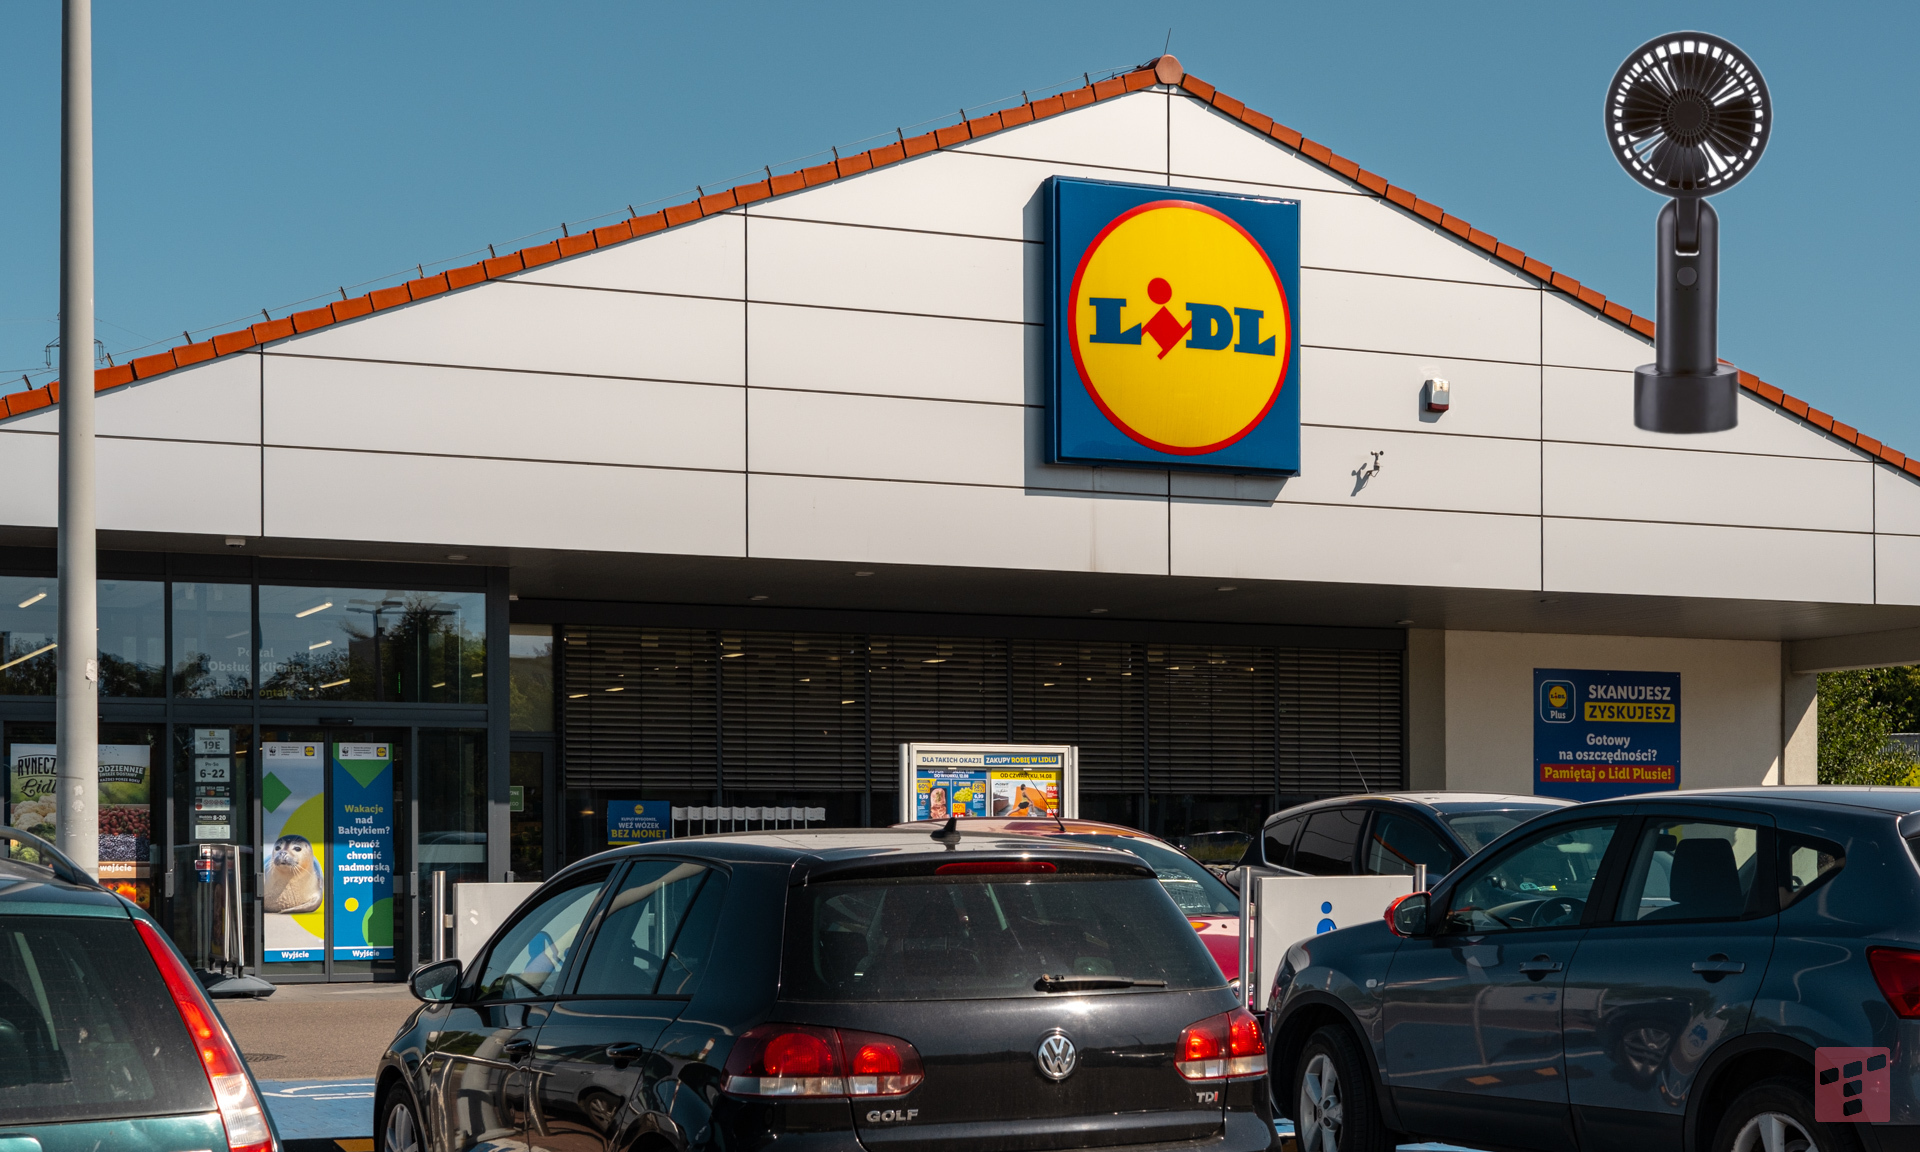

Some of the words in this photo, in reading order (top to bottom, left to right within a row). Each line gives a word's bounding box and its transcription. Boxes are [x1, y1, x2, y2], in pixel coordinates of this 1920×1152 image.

[1588, 684, 1671, 701] SKANUJESZ
[1550, 710, 1567, 719] Plus
[1588, 704, 1671, 720] ZYSKUJESZ
[203, 741, 221, 750] 19E
[1586, 733, 1631, 749] Gotowy
[1558, 750, 1573, 760] na
[1575, 748, 1658, 763] oszczędności?
[1011, 757, 1031, 765] ROBIĘ
[98, 765, 144, 775] ODZIENNIE
[200, 769, 225, 778] 6-22
[1544, 766, 1596, 782] Pamiętaj
[1598, 770, 1605, 779] o
[1608, 767, 1630, 779] Lidl
[1632, 767, 1672, 780] Plusie!
[344, 804, 384, 814] Wakacje
[355, 816, 373, 824] nad
[618, 821, 634, 829] WEŹ
[634, 821, 660, 829] WÓZEK
[338, 826, 391, 836] Bałtykiem?
[611, 829, 630, 838] BEZ
[631, 829, 667, 839] MONET
[349, 840, 380, 848] Pomóż
[346, 851, 382, 860] chronić
[100, 863, 132, 873] wejście
[338, 863, 391, 873] nadmorską
[343, 874, 386, 885] przyrodę
[281, 951, 310, 960] Wyjście
[352, 950, 380, 958] Wyjście
[1196, 1091, 1219, 1103] TDI
[866, 1109, 919, 1123] GOLF
